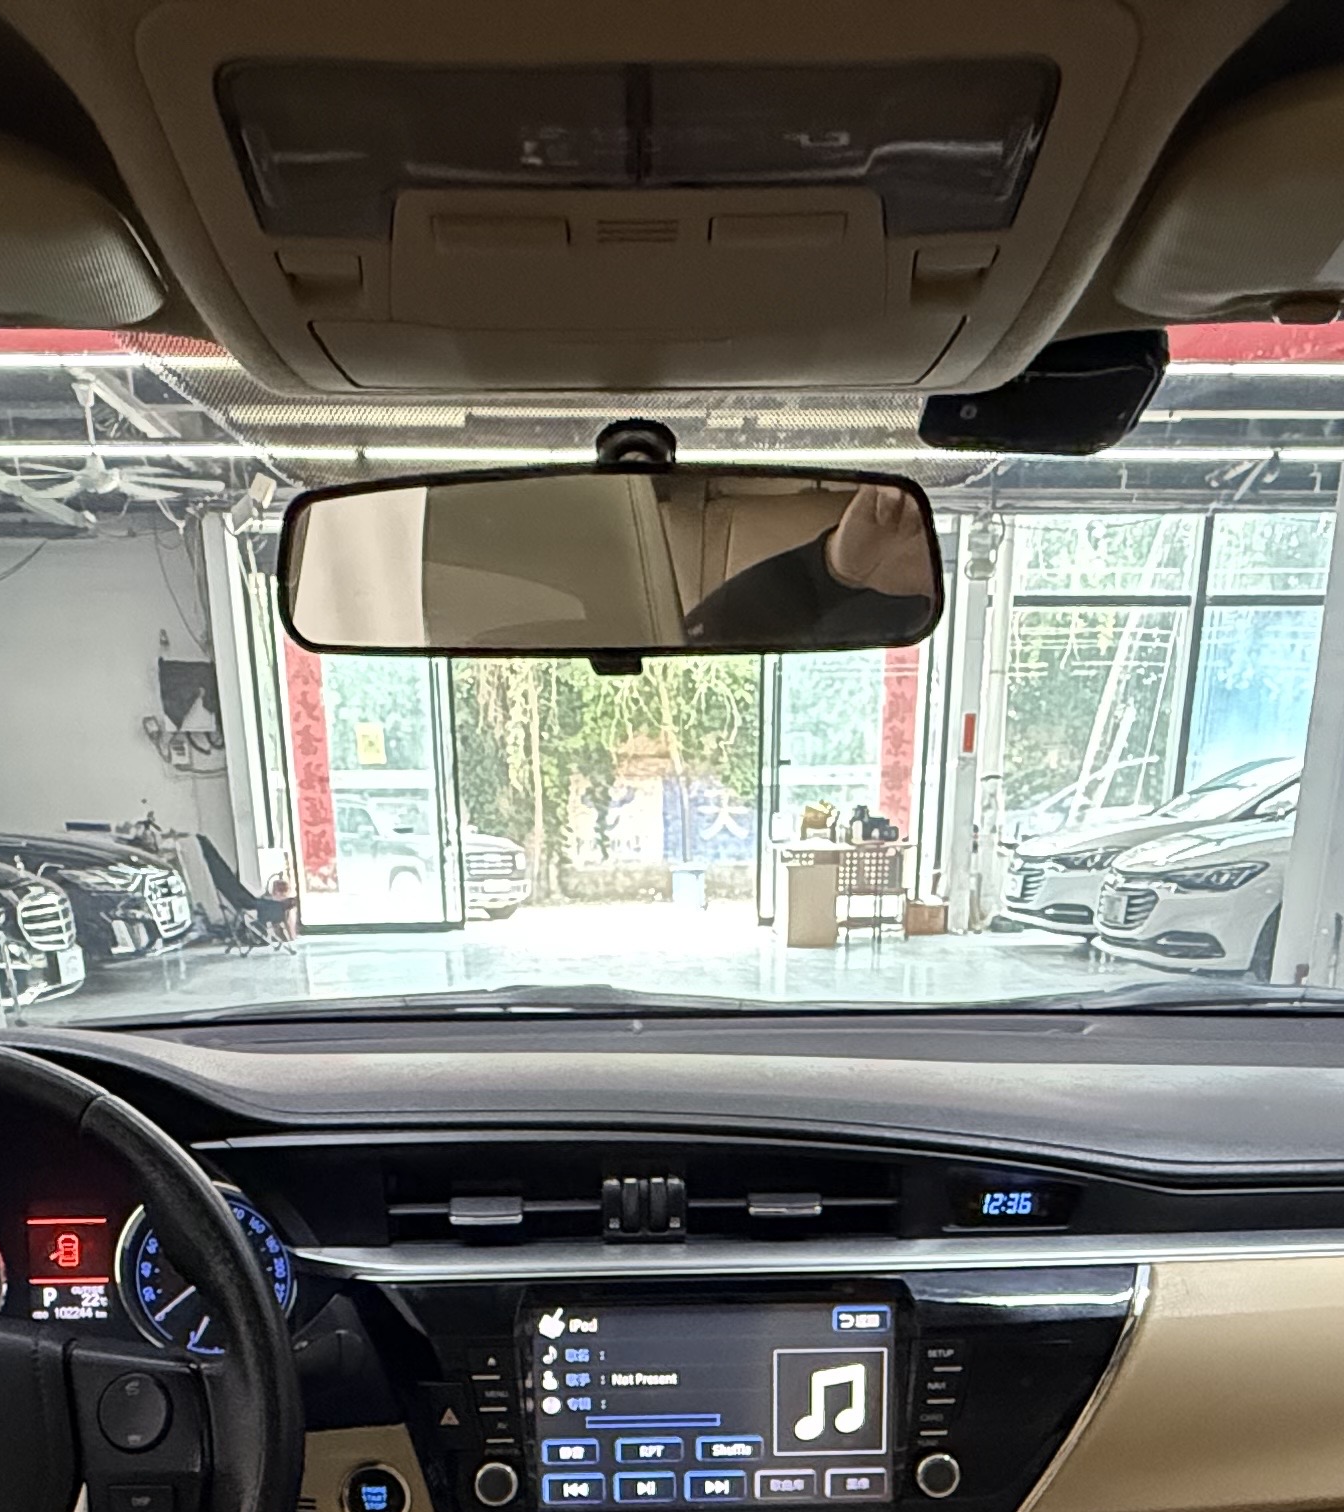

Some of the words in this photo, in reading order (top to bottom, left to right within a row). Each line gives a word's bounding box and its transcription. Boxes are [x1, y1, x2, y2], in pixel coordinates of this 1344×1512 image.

[982, 1192, 1032, 1215] 12:36
[42, 1286, 58, 1308] P
[635, 1372, 678, 1387] Present
